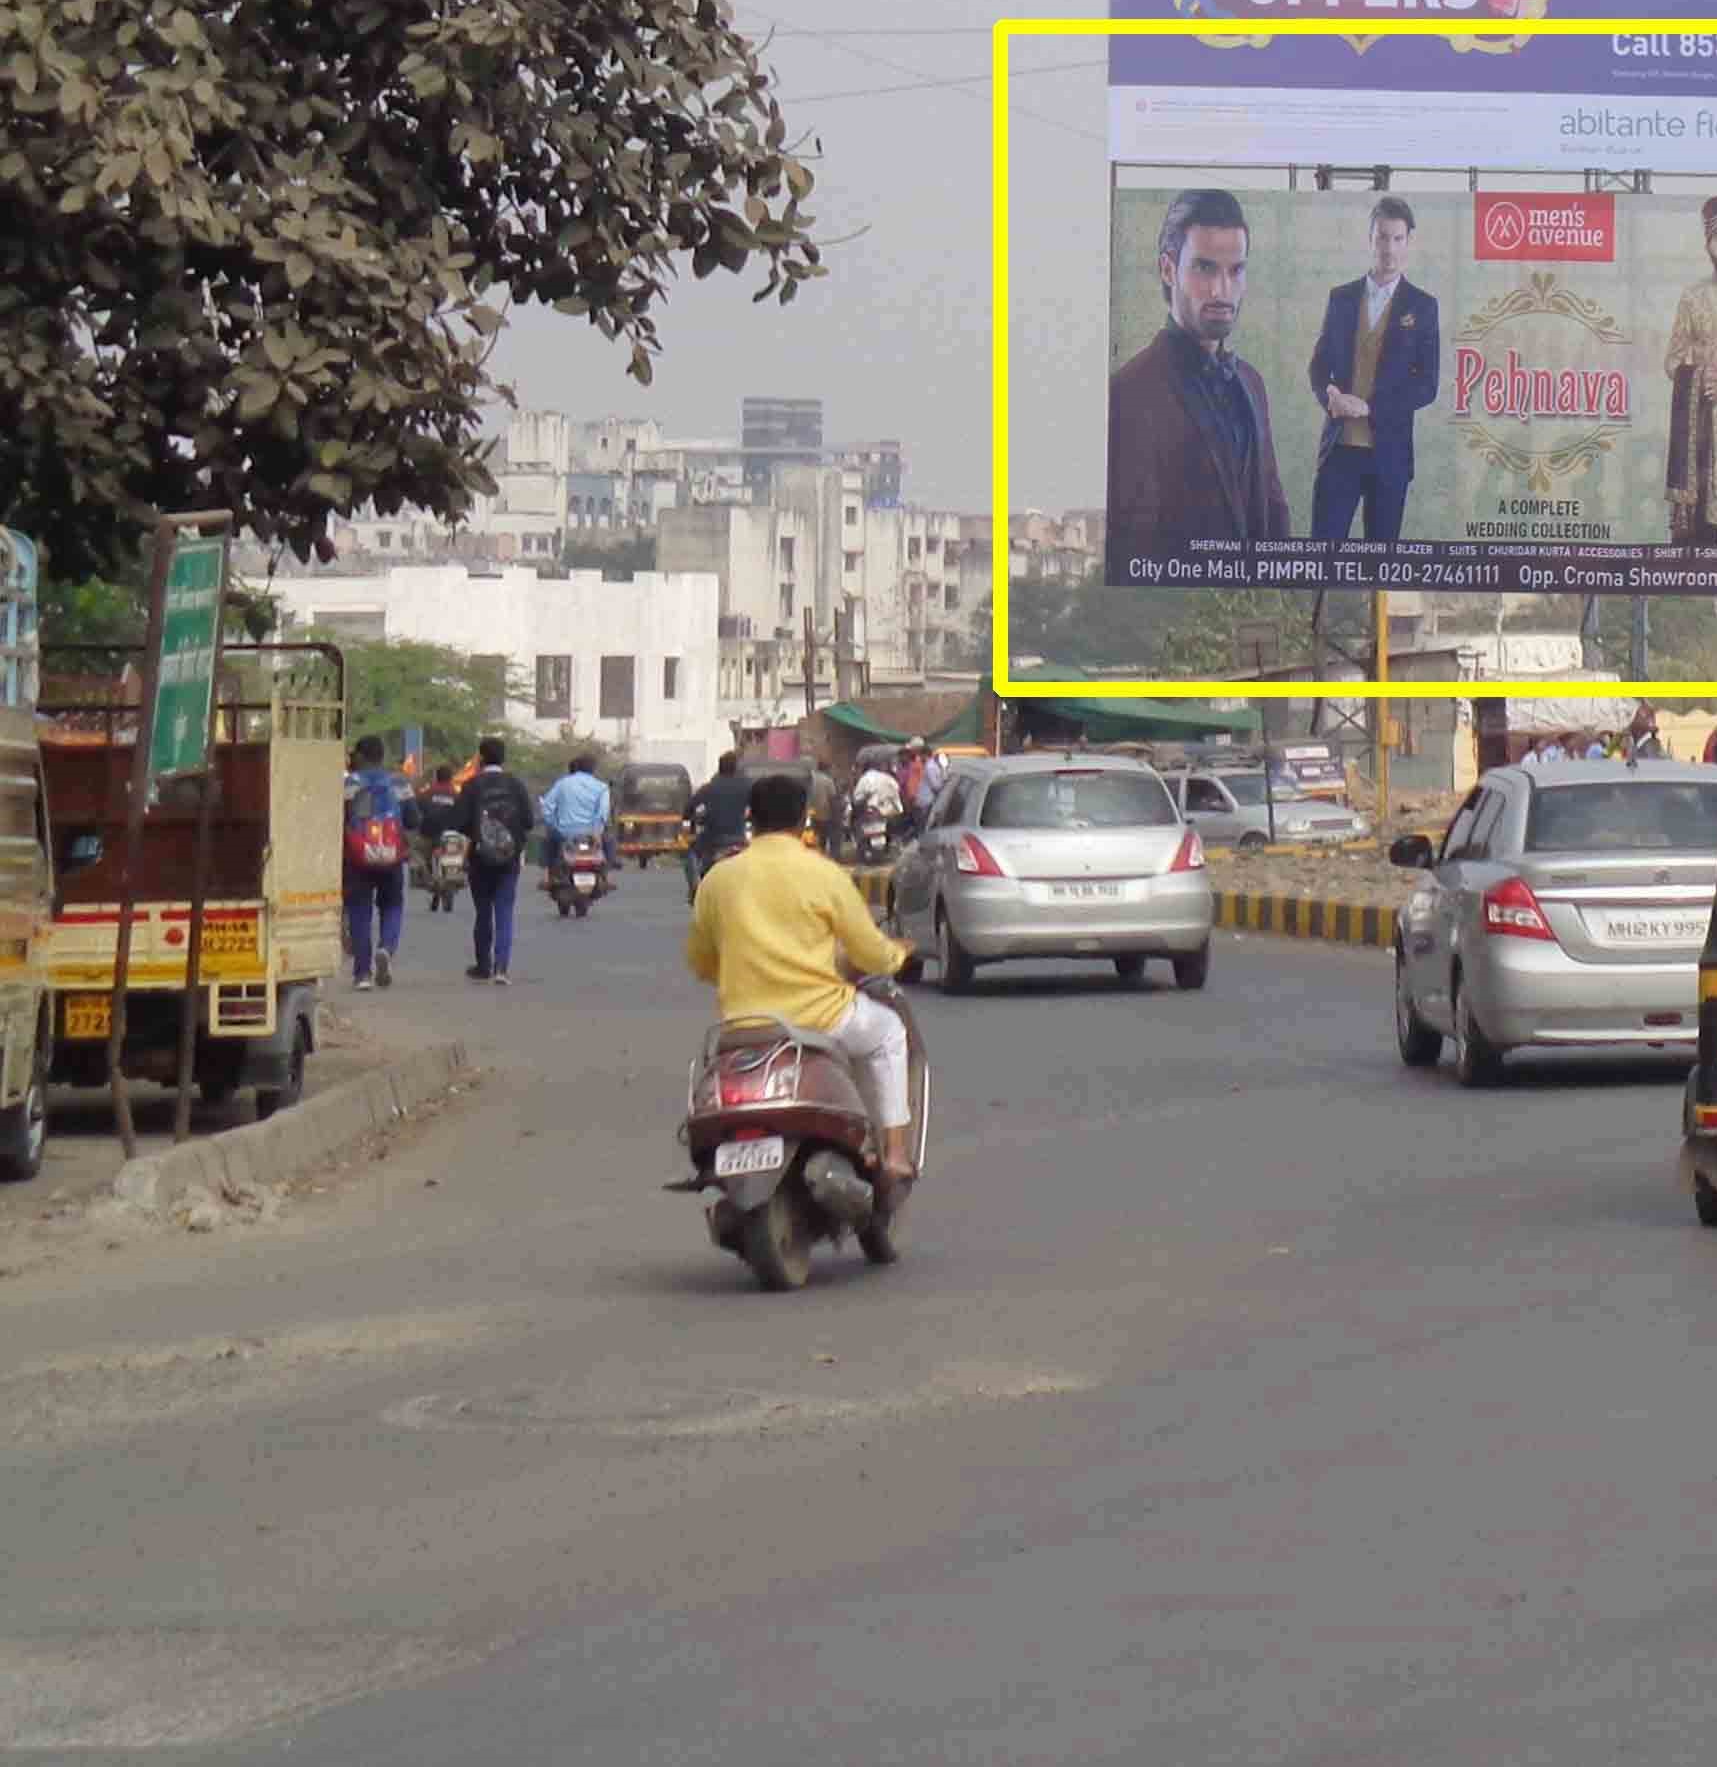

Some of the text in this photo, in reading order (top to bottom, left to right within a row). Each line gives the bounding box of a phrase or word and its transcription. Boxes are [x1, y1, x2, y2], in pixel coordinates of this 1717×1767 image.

[1612, 33, 1670, 57] Call
[1560, 109, 1686, 139] abitante
[1528, 203, 1585, 227] men's
[1528, 229, 1603, 247] avenue
[1454, 347, 1630, 422] Pehnava
[1498, 498, 1580, 516] A COMPLETE
[1466, 521, 1611, 540] WEDDING COLLECTION
[1189, 539, 1241, 552] SHERWANI
[1255, 540, 1304, 553] DESIGNER
[1306, 541, 1327, 553] SUIT
[1338, 542, 1387, 555] JODHPURI
[1396, 543, 1433, 555] BLAZER
[1449, 544, 1477, 556] SUITS
[1487, 544, 1537, 557] CHURIDAR
[1539, 545, 1571, 557] KURTA
[1577, 546, 1643, 559] ACCESSORIES
[1654, 547, 1684, 559] SHIRT
[1129, 558, 1162, 581] City
[1167, 559, 1203, 580] One
[1207, 559, 1251, 582] Mall,
[1257, 561, 1329, 581] PIMPRI.
[1334, 562, 1373, 582] TEL.
[1379, 562, 1499, 585] 020-27461111
[1519, 565, 1559, 588] Opp.
[1564, 565, 1624, 587] Croma
